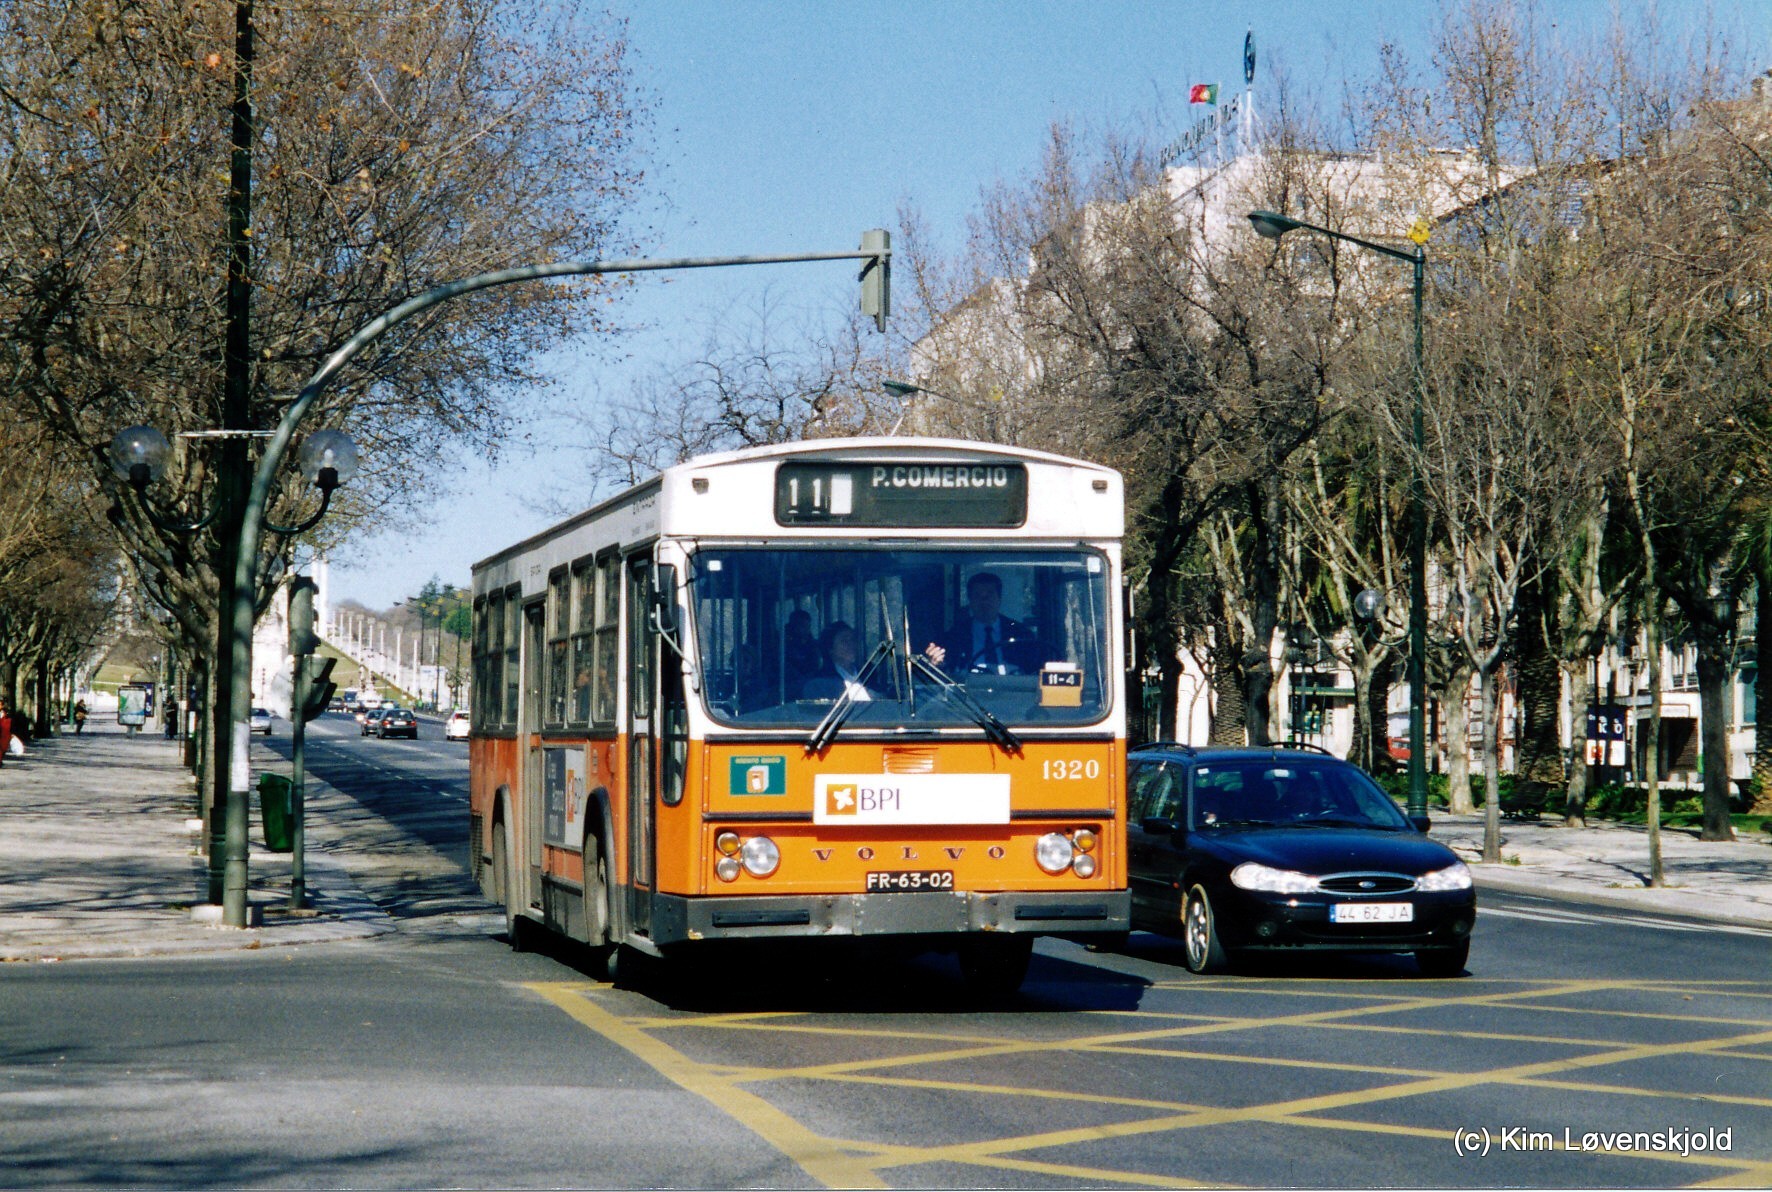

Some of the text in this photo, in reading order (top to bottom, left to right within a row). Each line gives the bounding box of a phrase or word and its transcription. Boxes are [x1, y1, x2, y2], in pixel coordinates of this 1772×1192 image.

[872, 466, 1008, 488] P.COMERCIO
[788, 477, 821, 507] 11
[1048, 673, 1075, 686] 11-4
[1043, 759, 1100, 781] 1320
[860, 788, 900, 811] BPI
[813, 846, 1005, 862] VOLVO
[867, 872, 953, 889] FR-63-02
